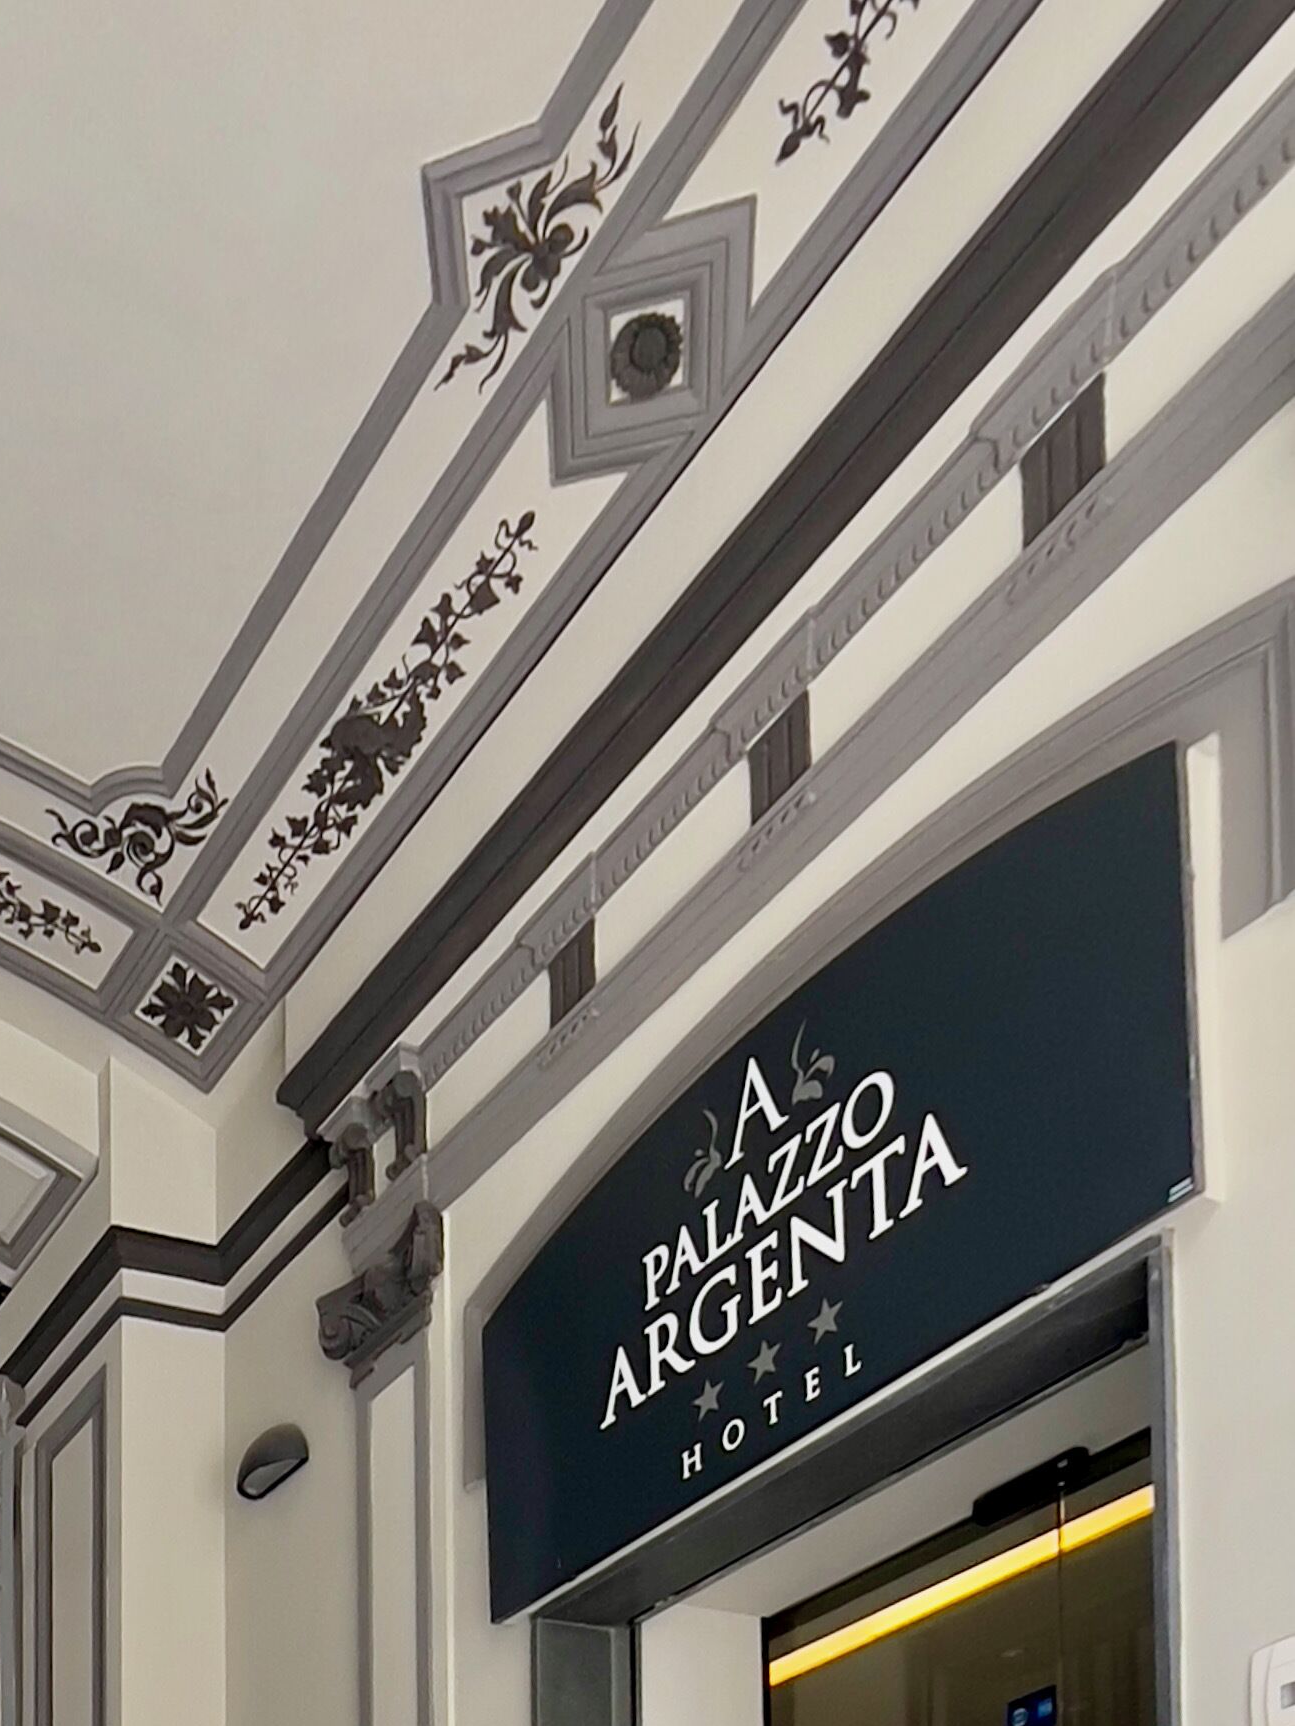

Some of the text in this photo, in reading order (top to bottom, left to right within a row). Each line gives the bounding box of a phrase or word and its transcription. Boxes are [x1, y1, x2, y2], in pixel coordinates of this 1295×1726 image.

[643, 1070, 895, 1311] PALAZZO
[724, 1057, 788, 1170] A
[600, 1113, 968, 1430] ARGENTA
[681, 1343, 863, 1480] HOTEL
